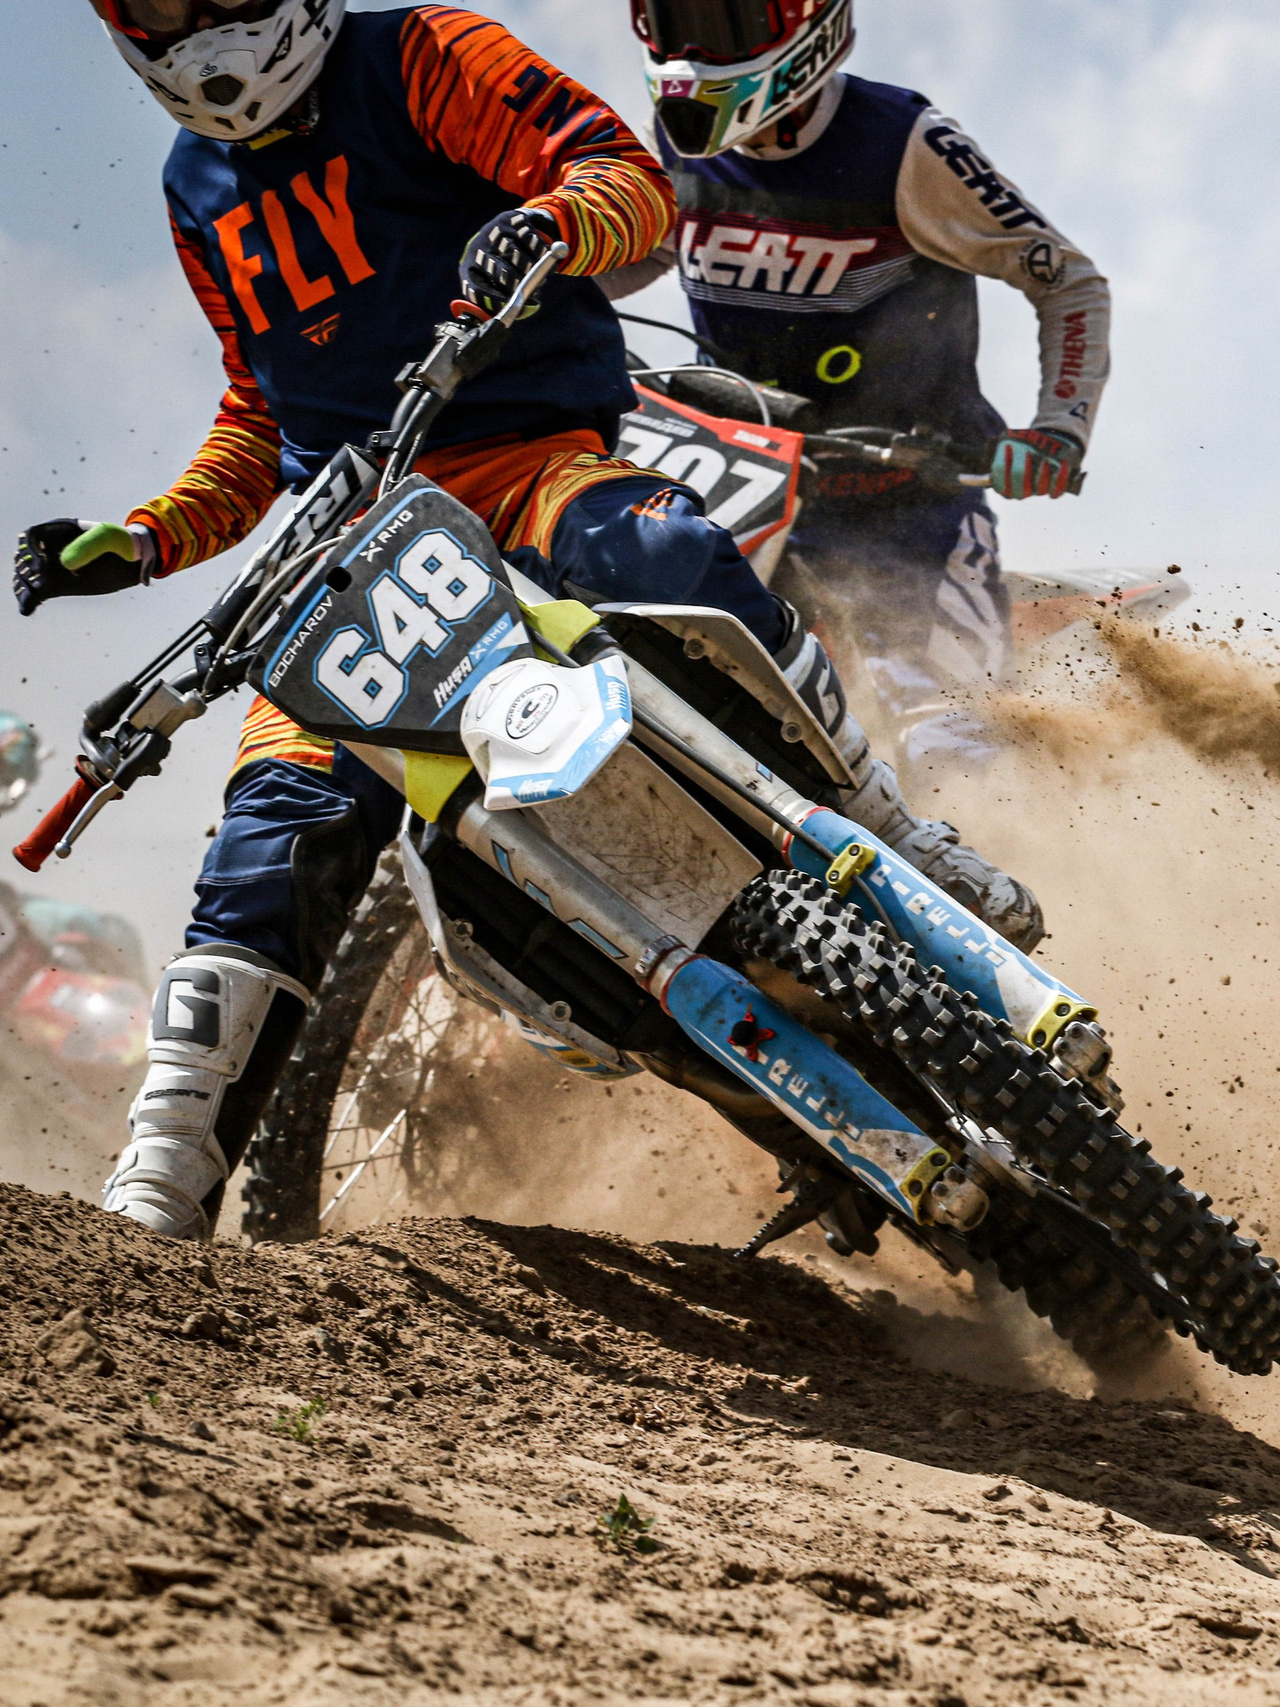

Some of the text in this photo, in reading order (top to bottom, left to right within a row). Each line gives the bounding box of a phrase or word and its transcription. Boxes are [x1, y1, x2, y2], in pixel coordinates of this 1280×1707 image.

[924, 126, 1047, 229] LEATT
[212, 154, 377, 336] FLY
[679, 221, 878, 295] LEATT
[268, 596, 333, 688] BOCHAROV
[312, 527, 497, 731] 648
[868, 864, 1006, 968] PIRELLI
